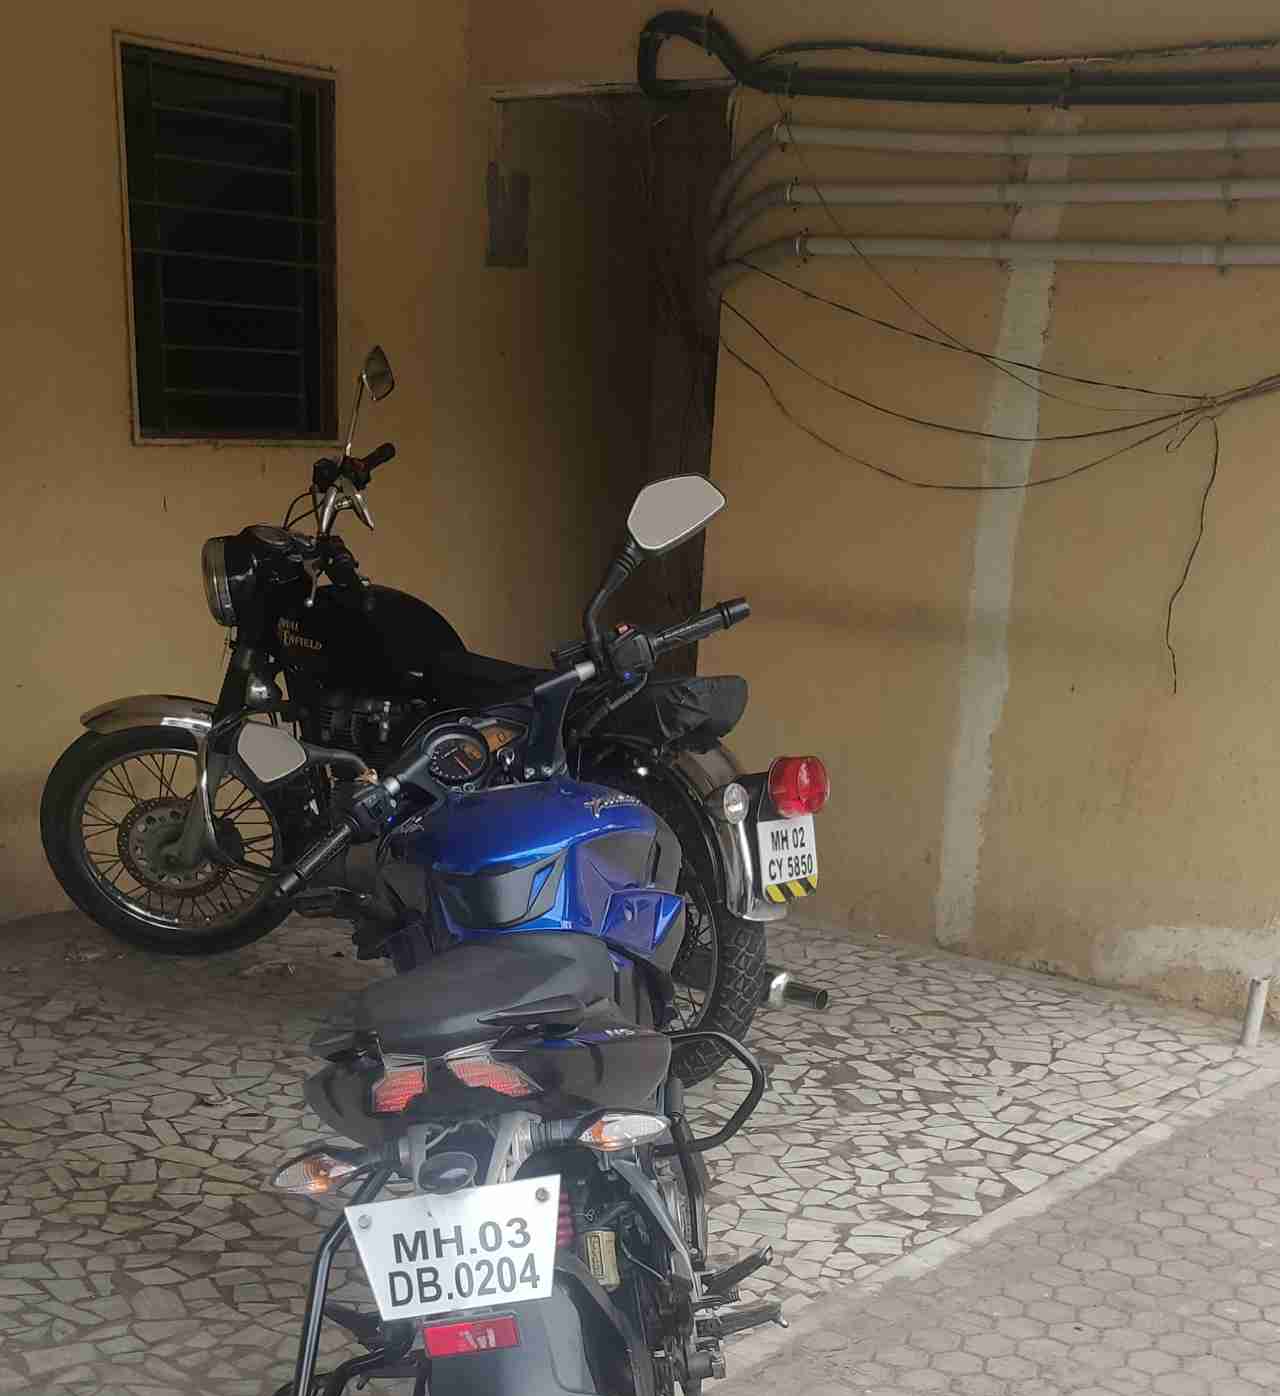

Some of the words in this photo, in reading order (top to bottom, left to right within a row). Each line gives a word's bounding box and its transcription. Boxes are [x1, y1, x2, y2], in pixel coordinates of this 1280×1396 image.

[770, 828, 789, 851] MH
[791, 826, 806, 849] 02
[768, 858, 784, 881] CY
[787, 854, 814, 878] 5850
[392, 1217, 532, 1264] MH.03
[388, 1253, 541, 1308] DB.0204
